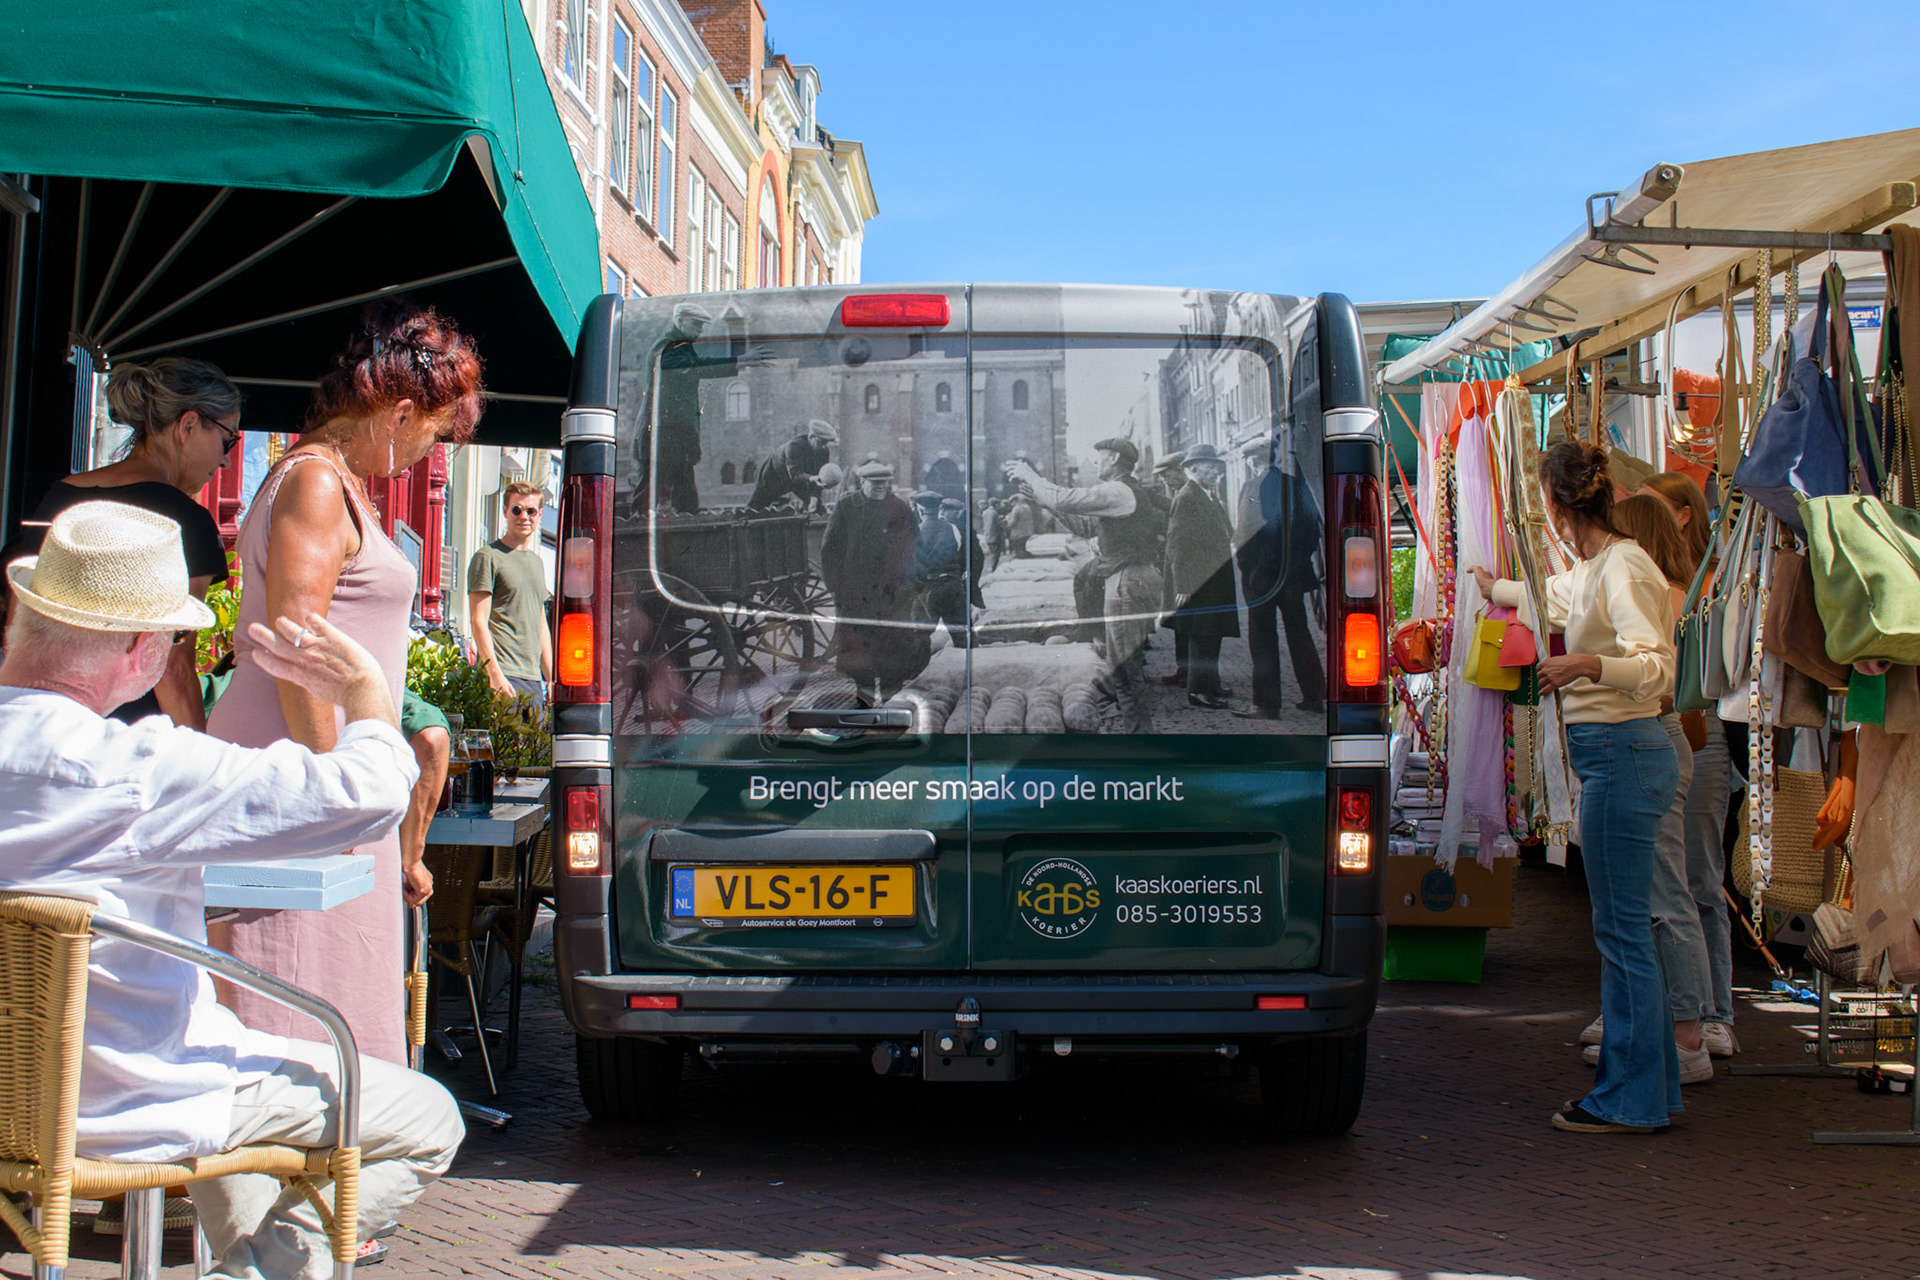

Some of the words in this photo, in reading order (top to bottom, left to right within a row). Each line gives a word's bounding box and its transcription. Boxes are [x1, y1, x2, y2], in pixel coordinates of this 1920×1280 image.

[750, 775, 843, 808] Brengt
[850, 780, 919, 800] meer
[925, 774, 1016, 800] smaak
[1022, 780, 1055, 809] op
[1063, 774, 1096, 800] de
[1103, 774, 1185, 801] markt
[1026, 876, 1035, 886] DE
[1033, 862, 1093, 887] NOORD-HOLLANDSE
[1115, 874, 1263, 894] kaaskoeriers.nl
[715, 875, 890, 910] VLS-16-F
[675, 898, 692, 909] NL
[741, 919, 784, 927] Autoservice
[798, 919, 817, 928] Goey
[819, 919, 856, 927] Montfoort
[1116, 905, 1262, 924] 085-3019553
[1032, 916, 1087, 934] KOERIER
